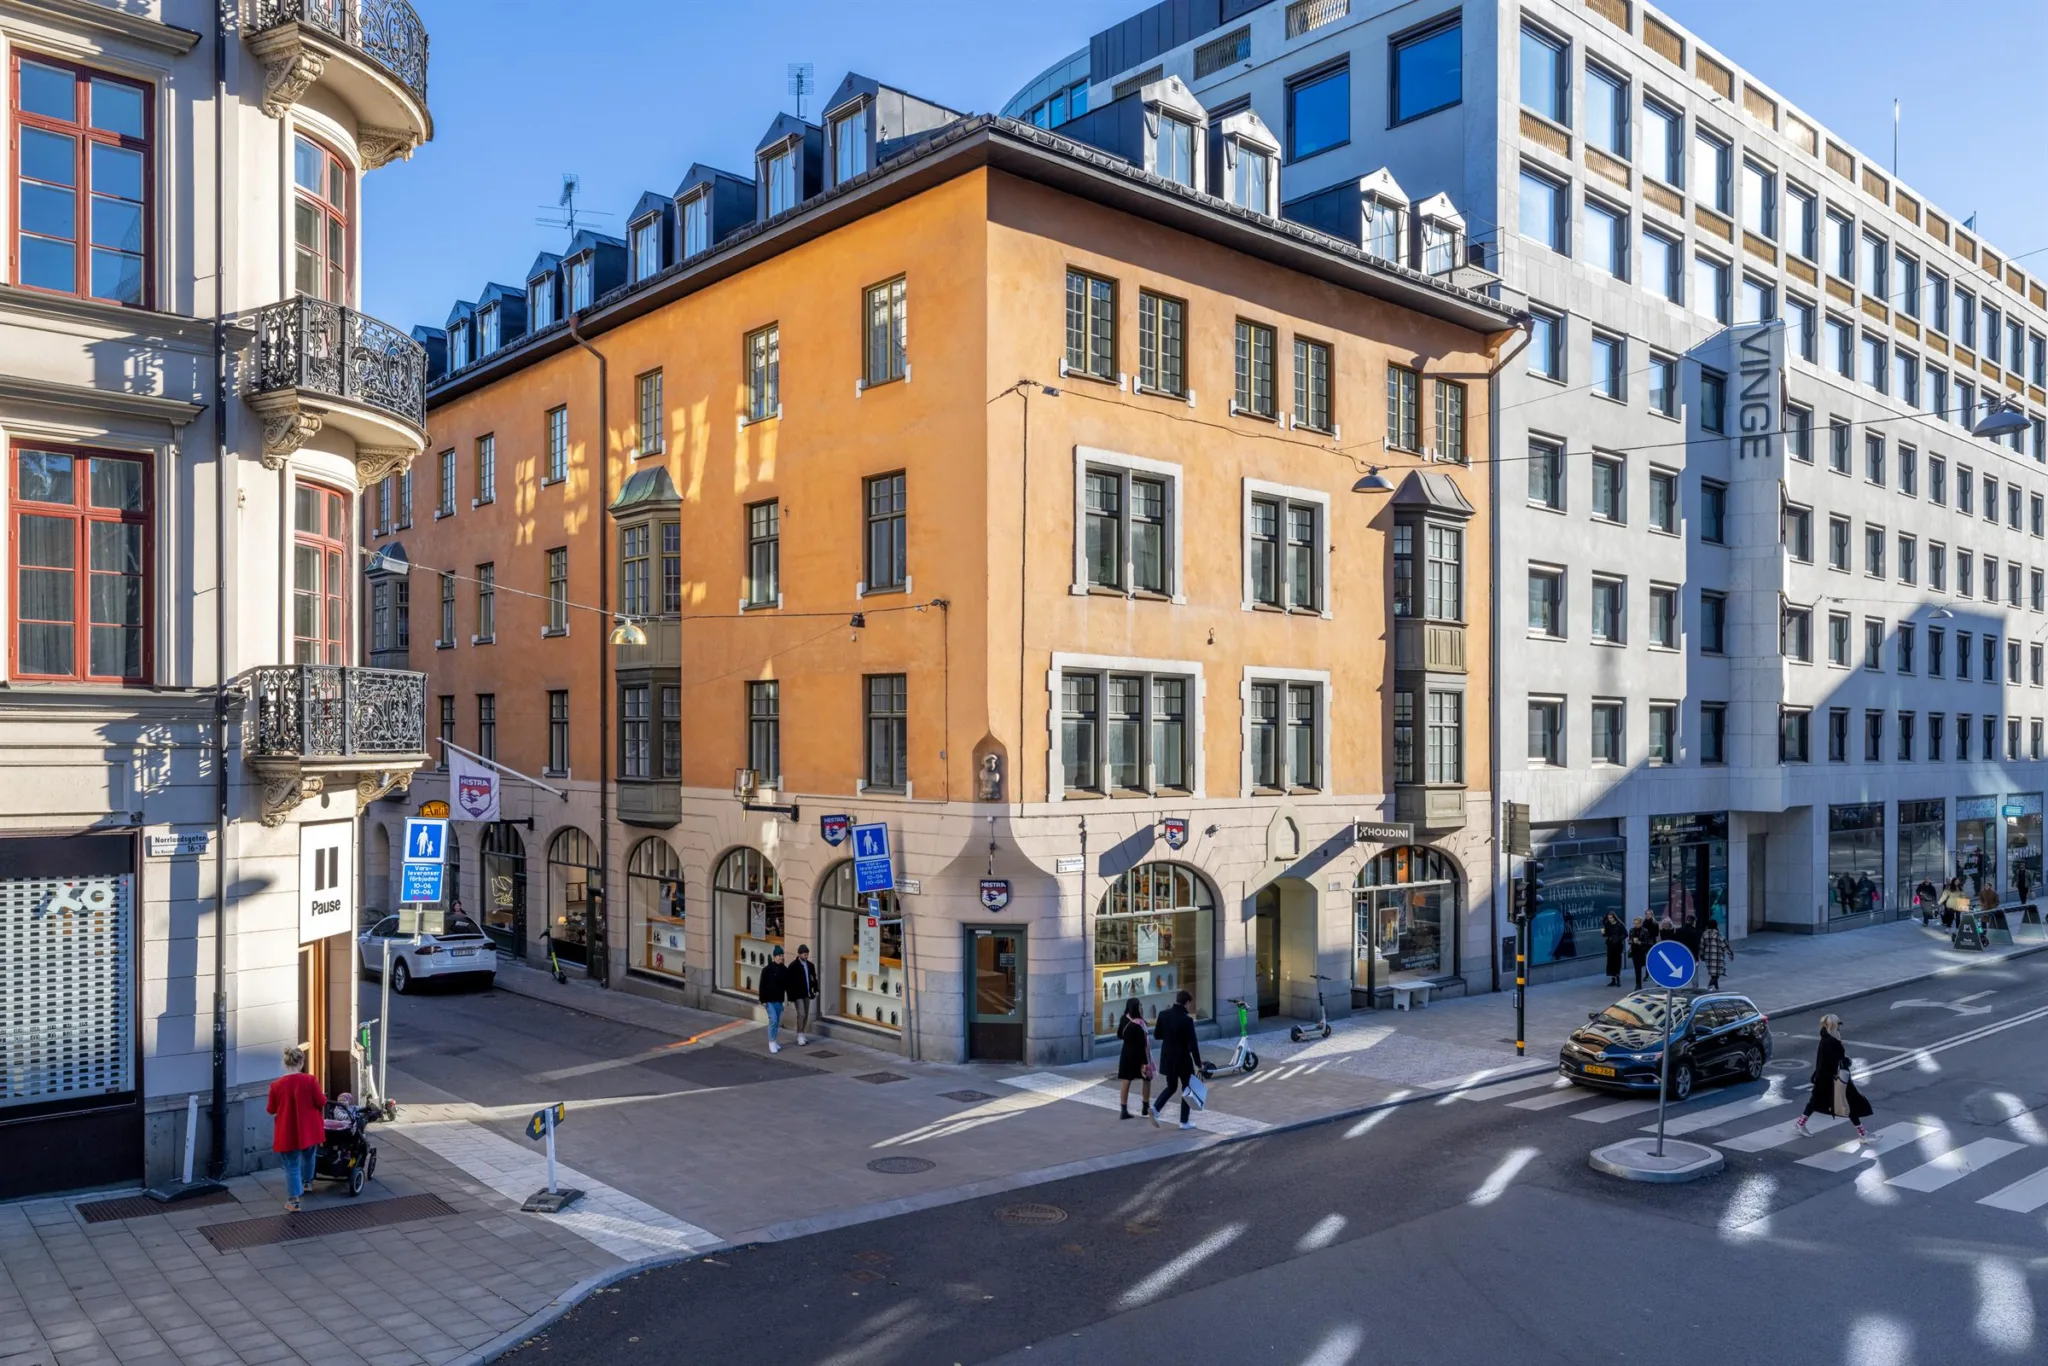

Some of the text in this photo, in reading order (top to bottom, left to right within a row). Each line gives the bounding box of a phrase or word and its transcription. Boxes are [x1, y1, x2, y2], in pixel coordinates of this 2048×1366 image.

[1740, 326, 1771, 460] VINGE
[460, 777, 489, 787] HESTRA
[1367, 827, 1409, 838] HOUDINI
[154, 836, 207, 844] Norrlandsgatan
[312, 899, 341, 917] Pause
